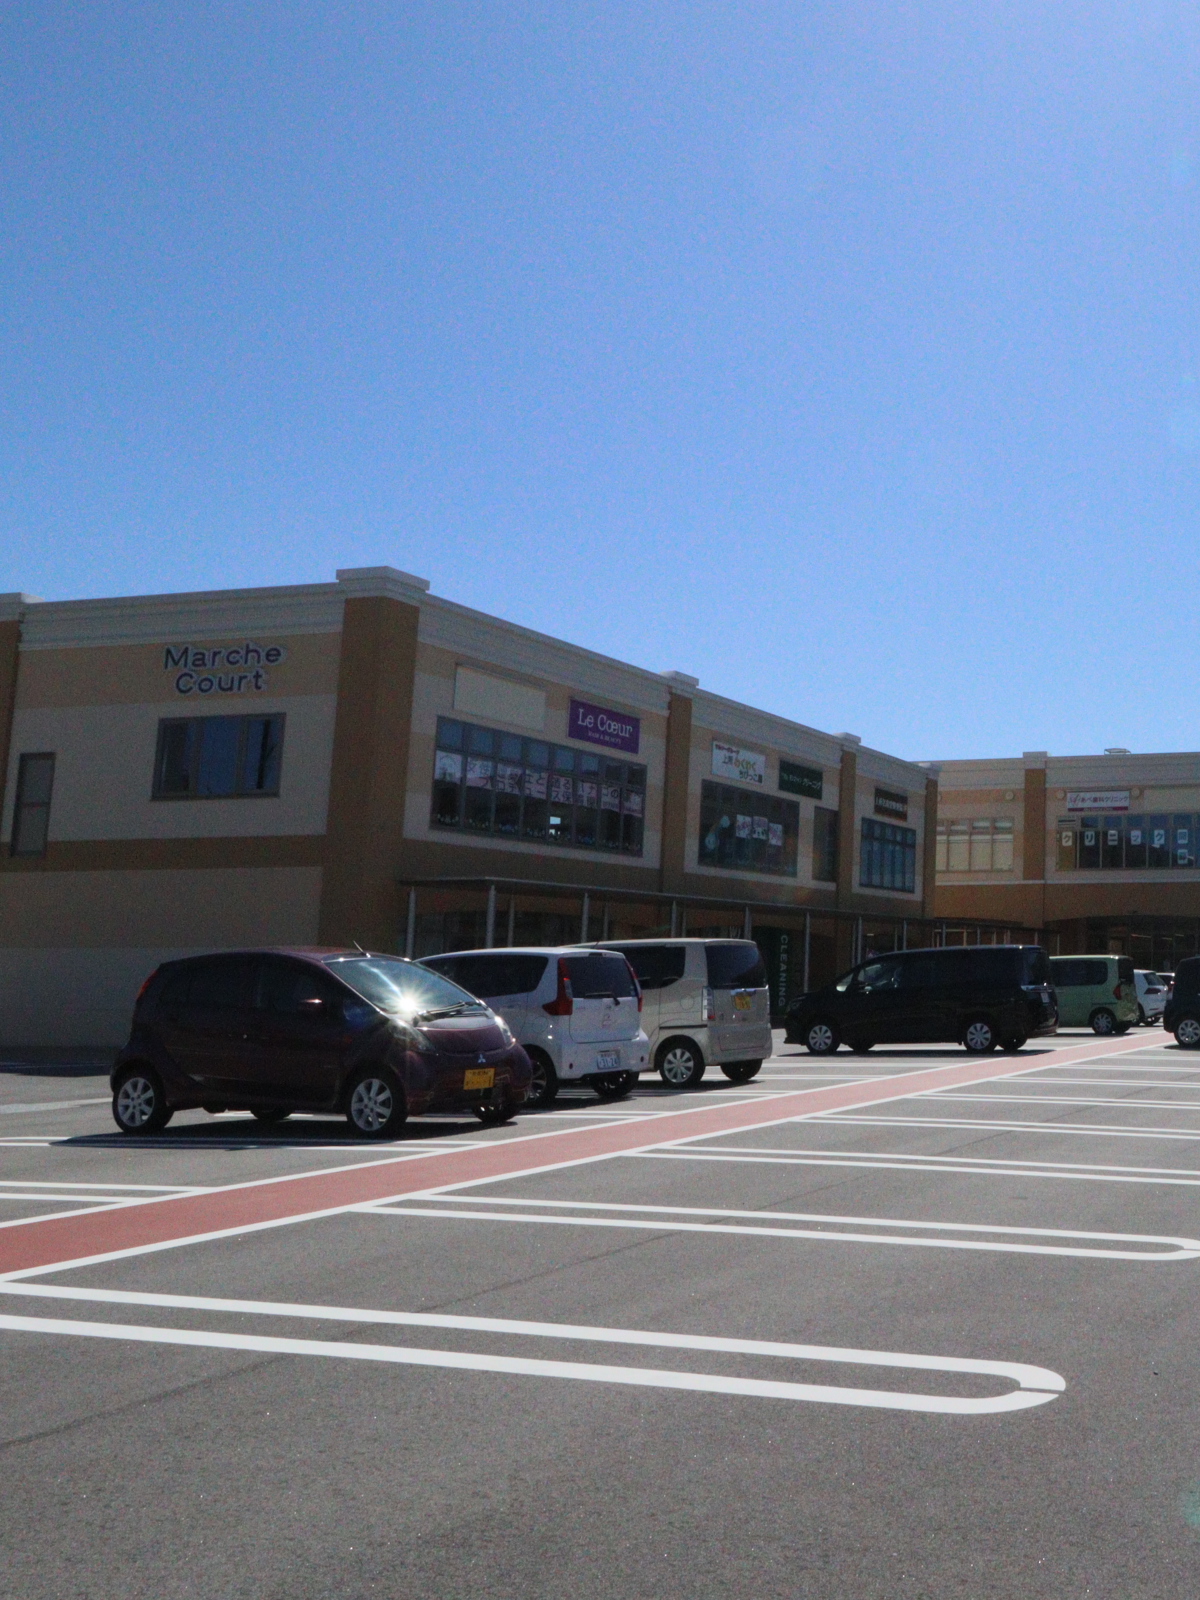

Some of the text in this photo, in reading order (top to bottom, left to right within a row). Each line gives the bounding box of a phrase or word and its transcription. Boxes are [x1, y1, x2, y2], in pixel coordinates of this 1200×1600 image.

[164, 643, 282, 670] Marche
[176, 670, 263, 694] Court
[577, 708, 594, 728] Le
[778, 934, 789, 1007] CLEANING
